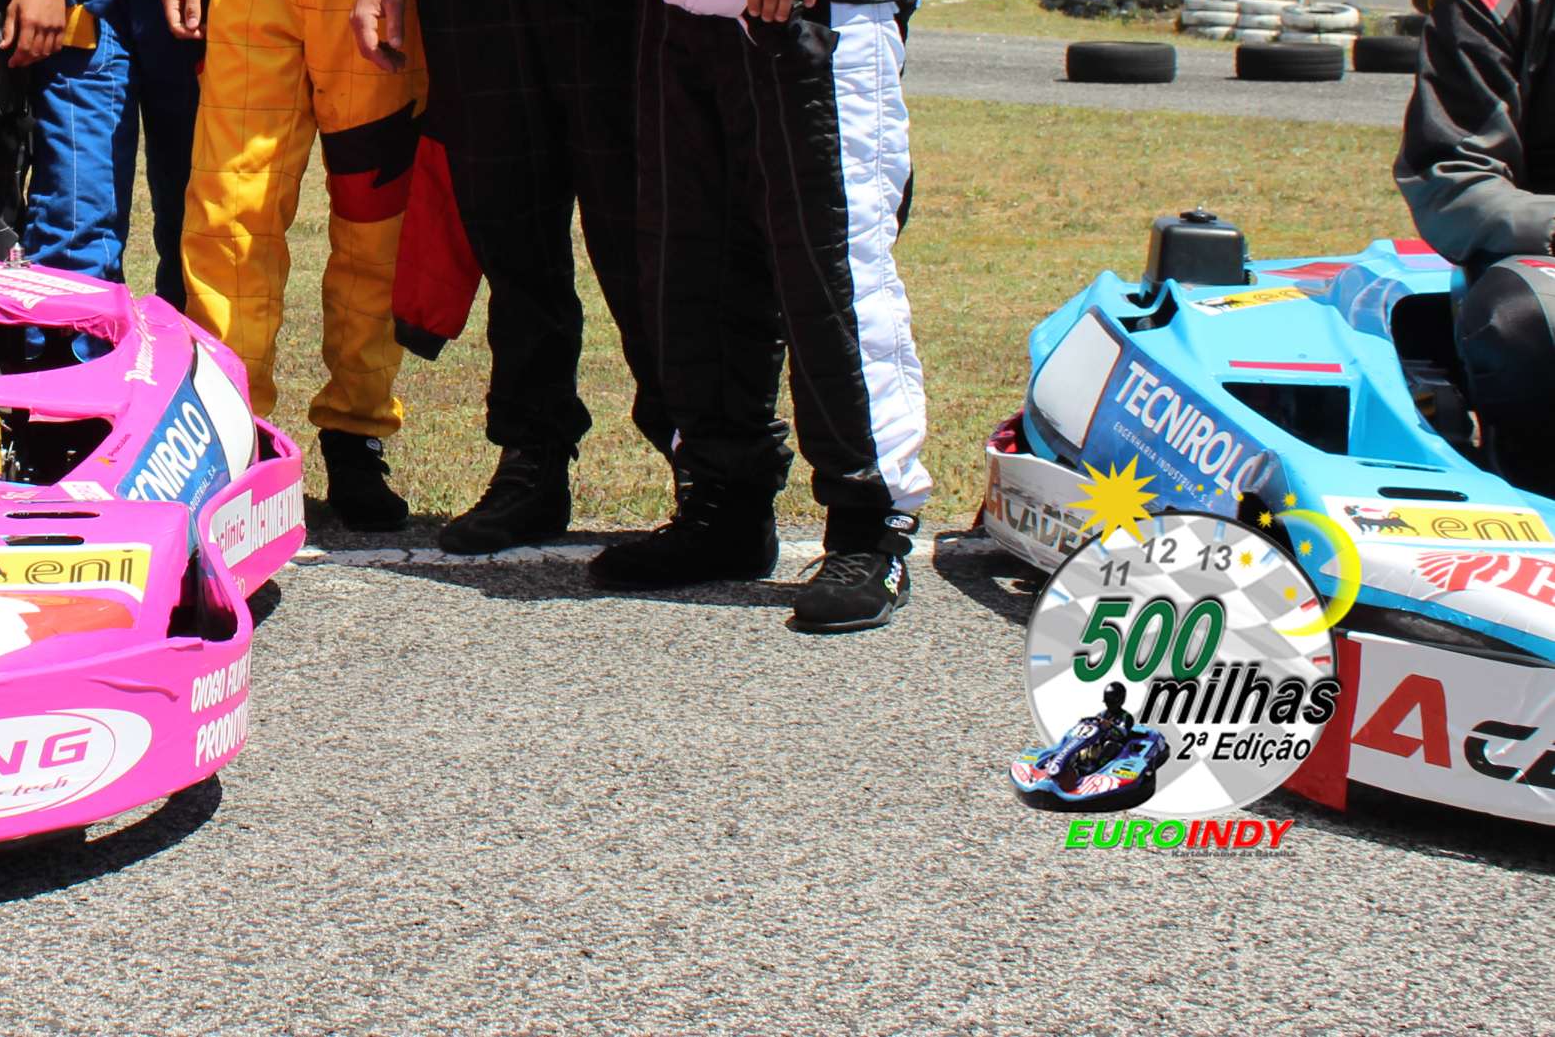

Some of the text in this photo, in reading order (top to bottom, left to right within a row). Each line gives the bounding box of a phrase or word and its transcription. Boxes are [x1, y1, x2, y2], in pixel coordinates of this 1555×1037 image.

[128, 399, 212, 501] CNIROLO
[1114, 360, 1276, 502] TECNIROLO
[1431, 512, 1541, 543] eni
[23, 549, 134, 586] eni
[190, 667, 226, 714] DIOGO
[1350, 673, 1555, 791] AC
[11, 775, 70, 799] tech
